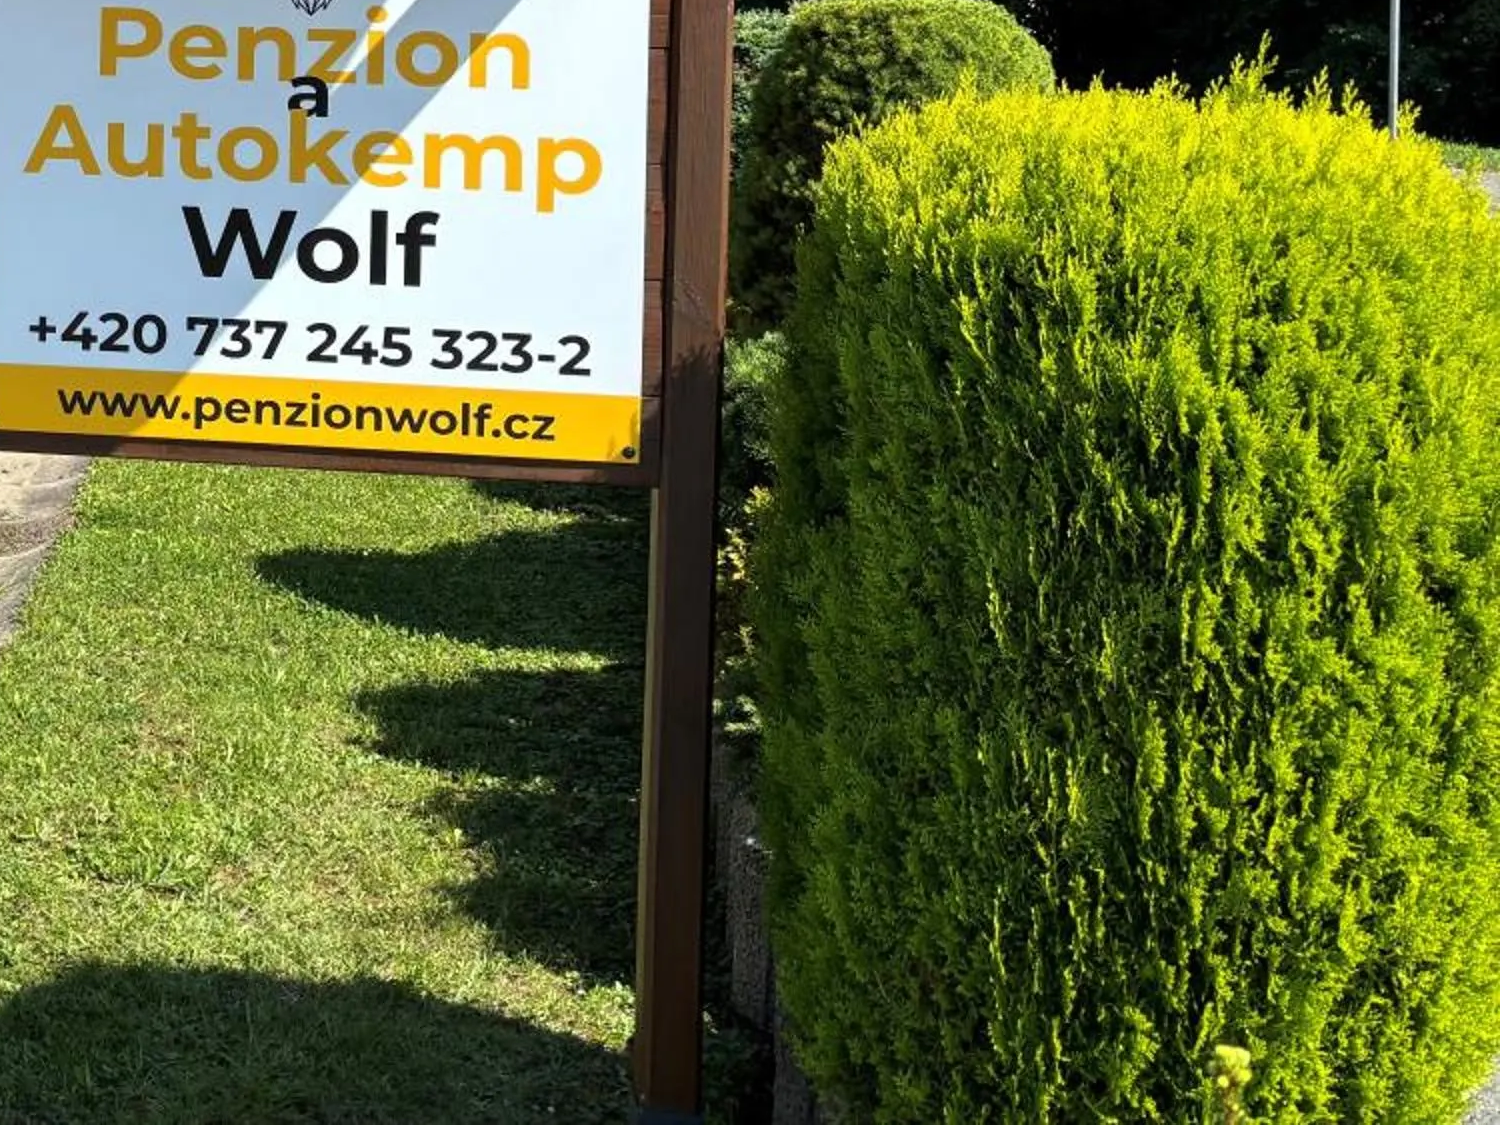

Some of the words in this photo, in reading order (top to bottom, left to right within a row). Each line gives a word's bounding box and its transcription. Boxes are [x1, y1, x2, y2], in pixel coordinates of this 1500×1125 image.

[98, 6, 532, 90] Penzion
[288, 75, 330, 118] a
[23, 104, 602, 213] Autokemp
[182, 205, 441, 288] Wolf
[28, 310, 168, 355] +420
[186, 316, 289, 361] 737
[305, 321, 413, 367] 245
[431, 327, 593, 378] 323-2
[56, 386, 557, 442] www.penzionwolf.cz
